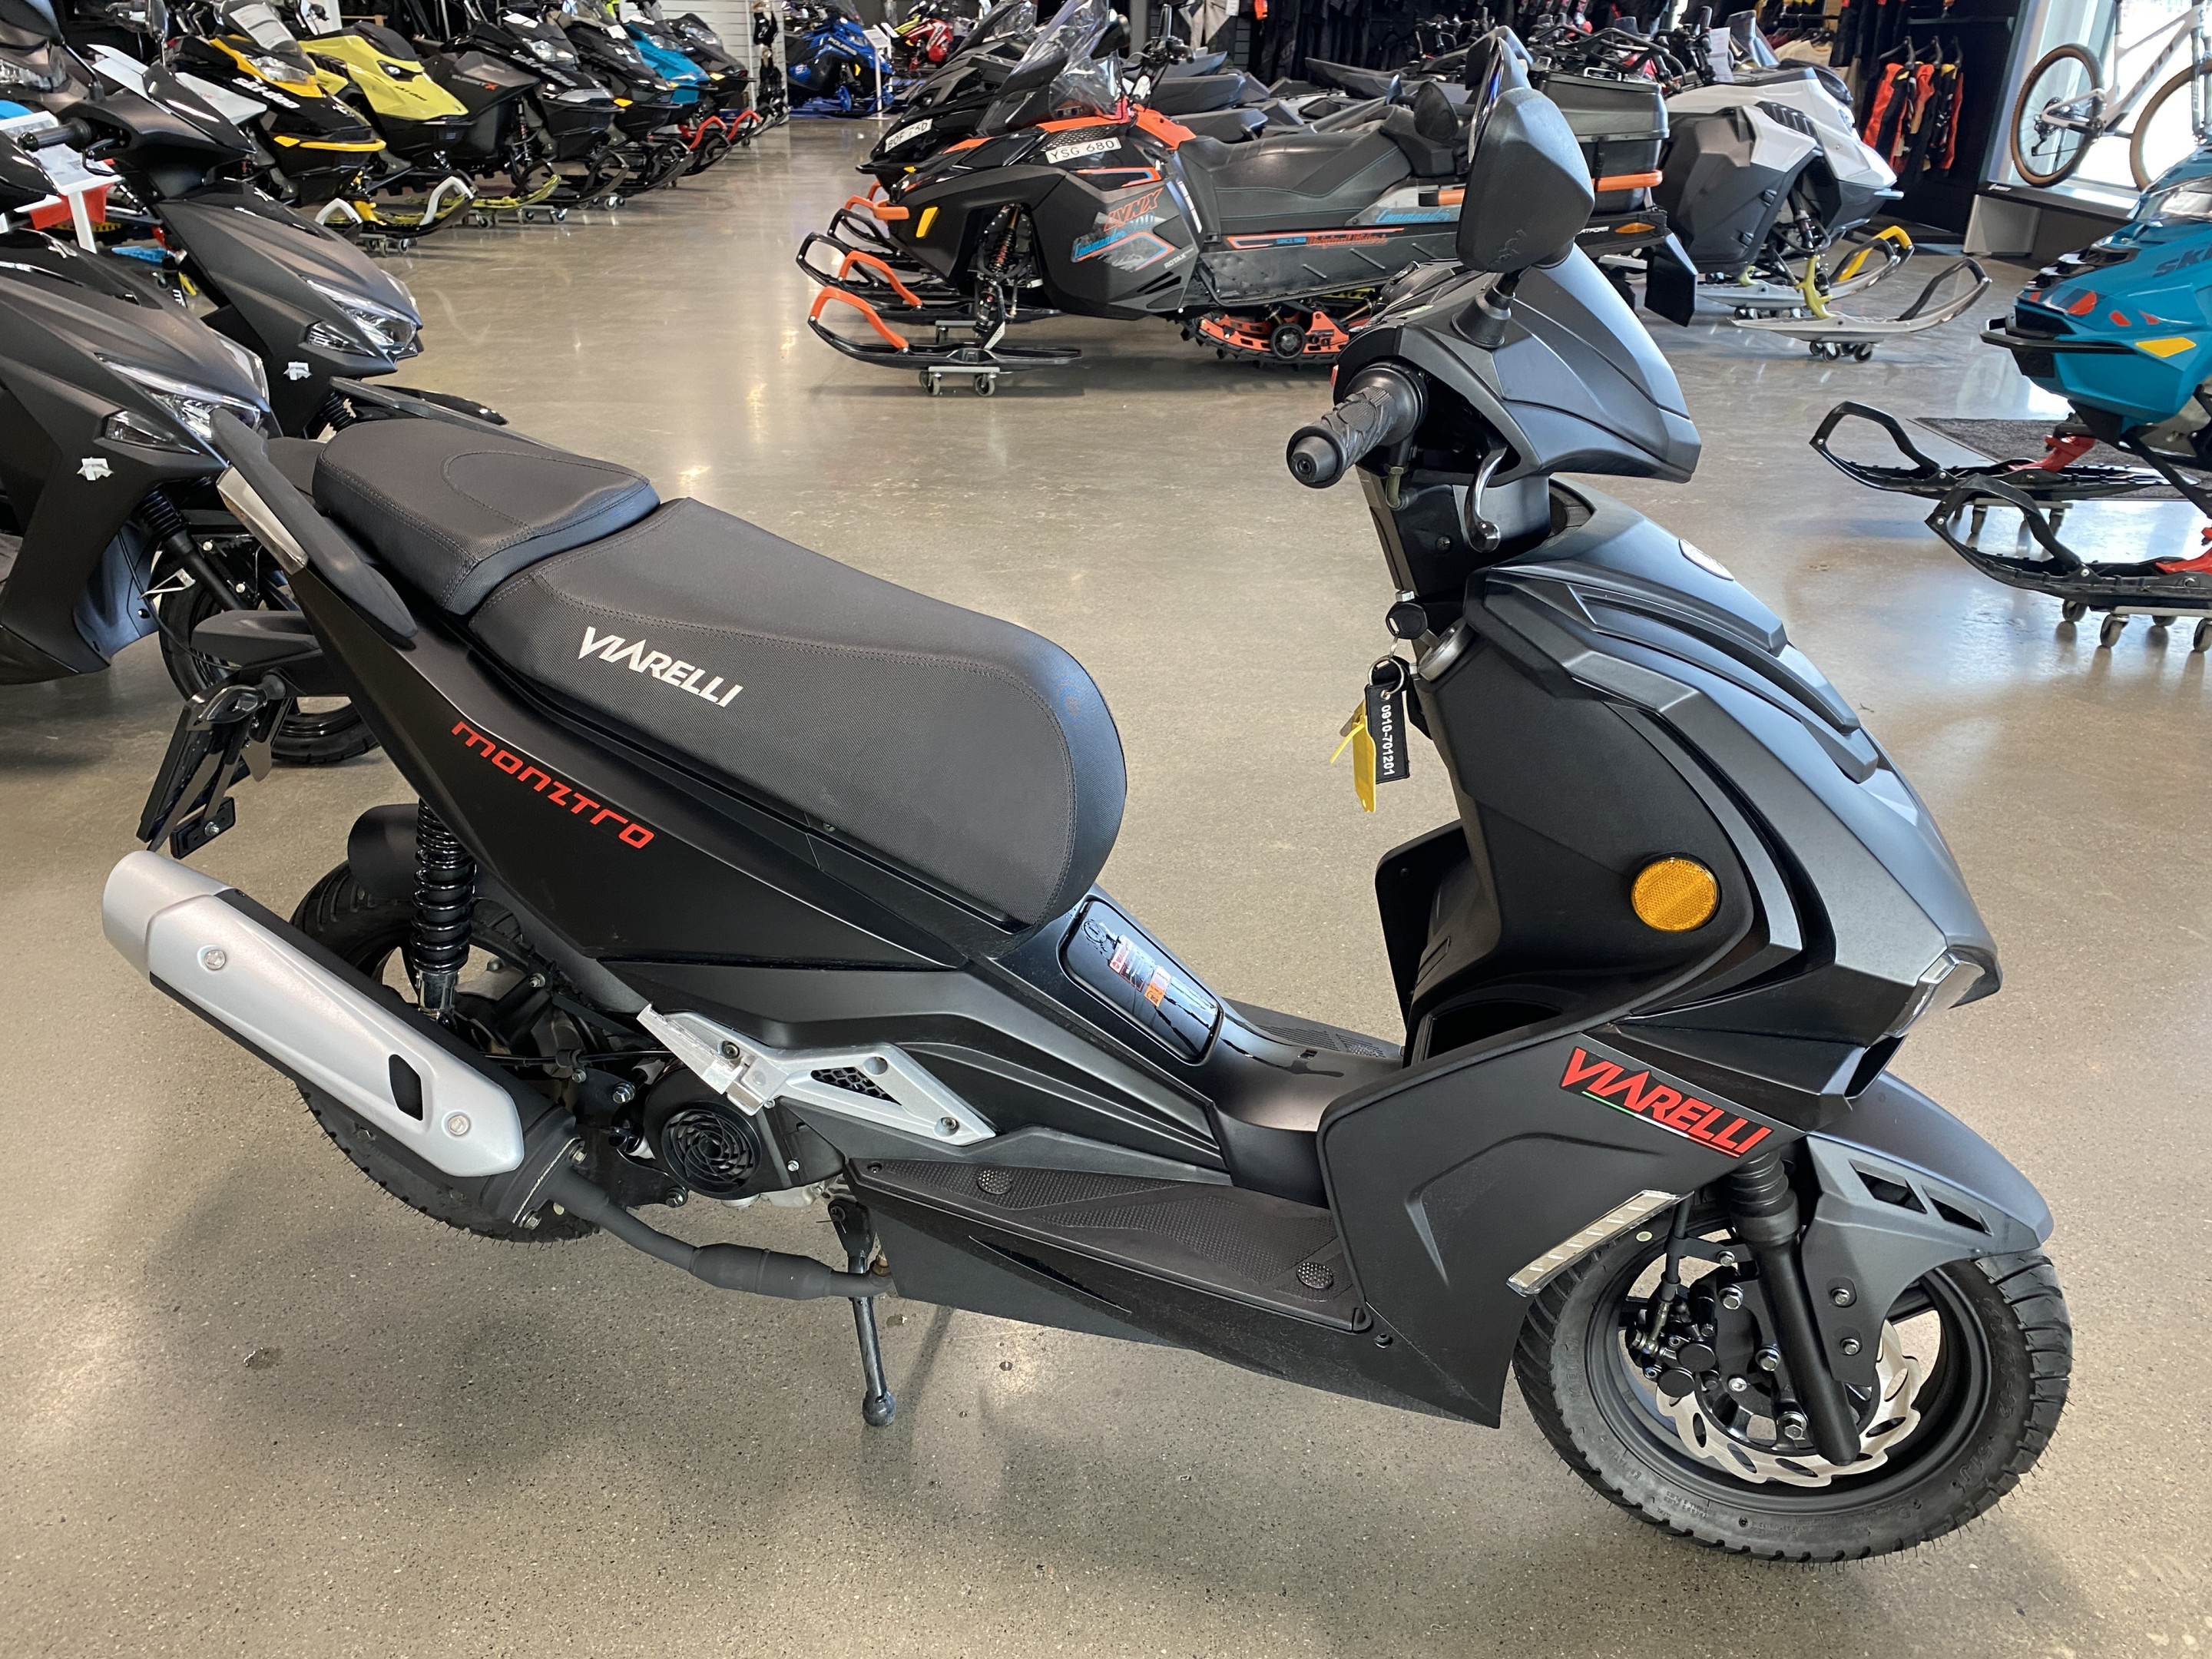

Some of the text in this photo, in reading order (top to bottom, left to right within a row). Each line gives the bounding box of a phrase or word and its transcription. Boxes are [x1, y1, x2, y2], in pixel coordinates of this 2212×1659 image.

[828, 37, 858, 56] POLARIS
[1049, 141, 1115, 161] YSG 680
[1103, 187, 1164, 232] LYNX
[1376, 206, 1452, 224] Commander
[1164, 253, 1187, 269] ROTAX
[578, 626, 743, 707] VIARELLI
[1381, 704, 1396, 776] 0910-701201
[1560, 1047, 1773, 1154] VIARELLI
